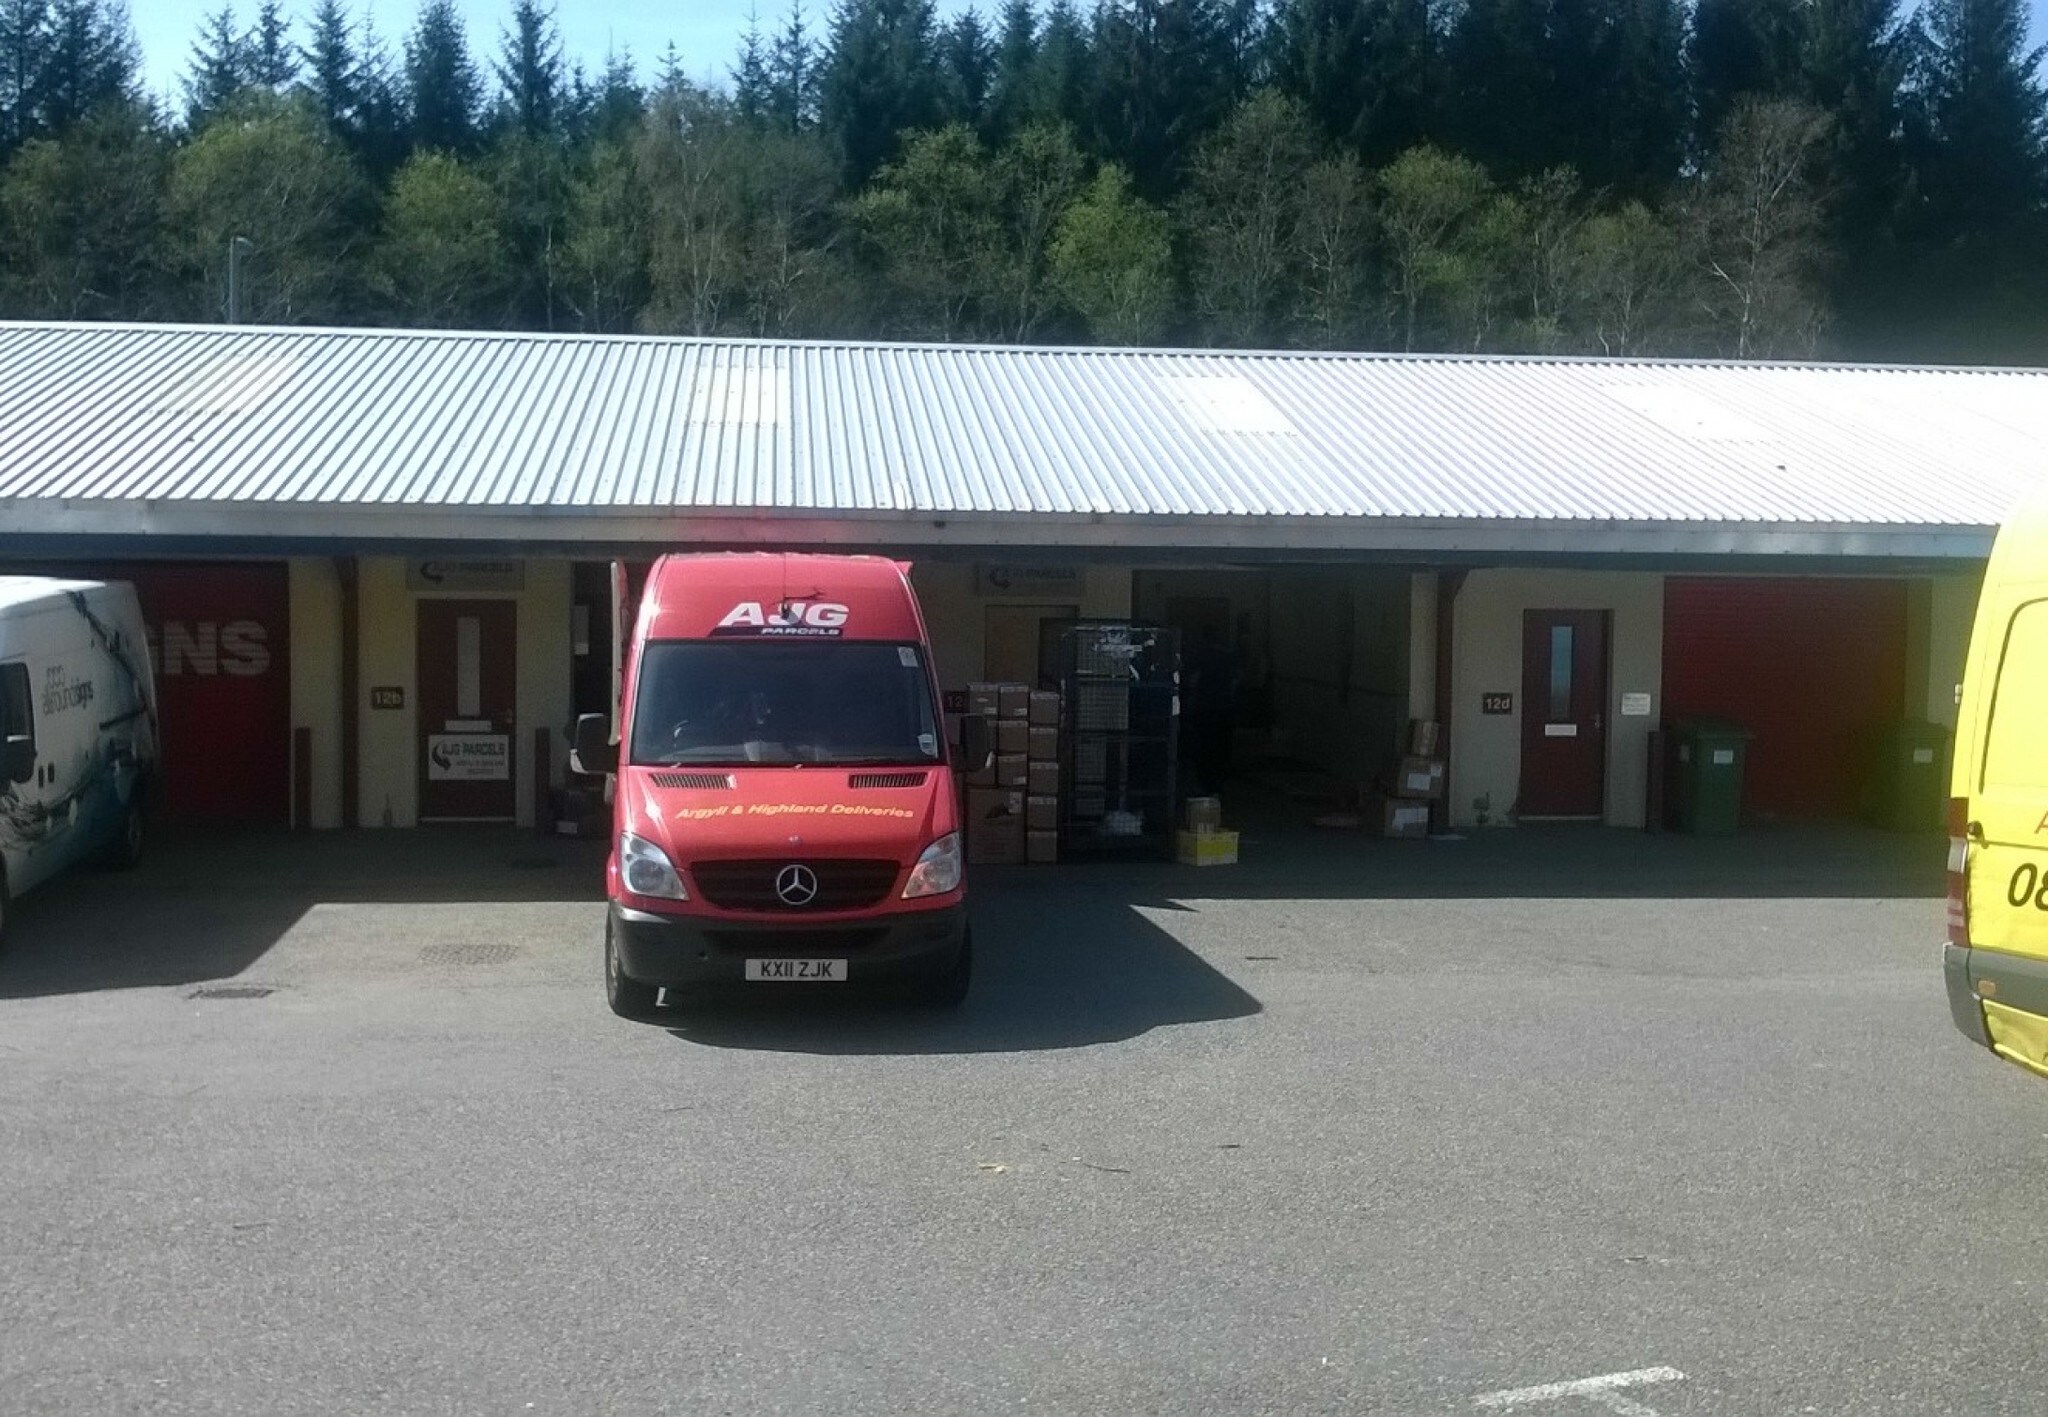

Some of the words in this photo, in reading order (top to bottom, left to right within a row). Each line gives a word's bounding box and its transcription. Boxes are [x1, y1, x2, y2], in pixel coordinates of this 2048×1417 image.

[718, 602, 849, 626] AJG
[761, 627, 840, 636] PARCELS
[1486, 697, 1510, 710] 12d
[675, 805, 729, 819] Argyll
[731, 805, 743, 815] &
[749, 804, 828, 816] Highland
[830, 803, 914, 818] Deliveries
[760, 961, 794, 977] KX11
[798, 961, 833, 977] ZJK
